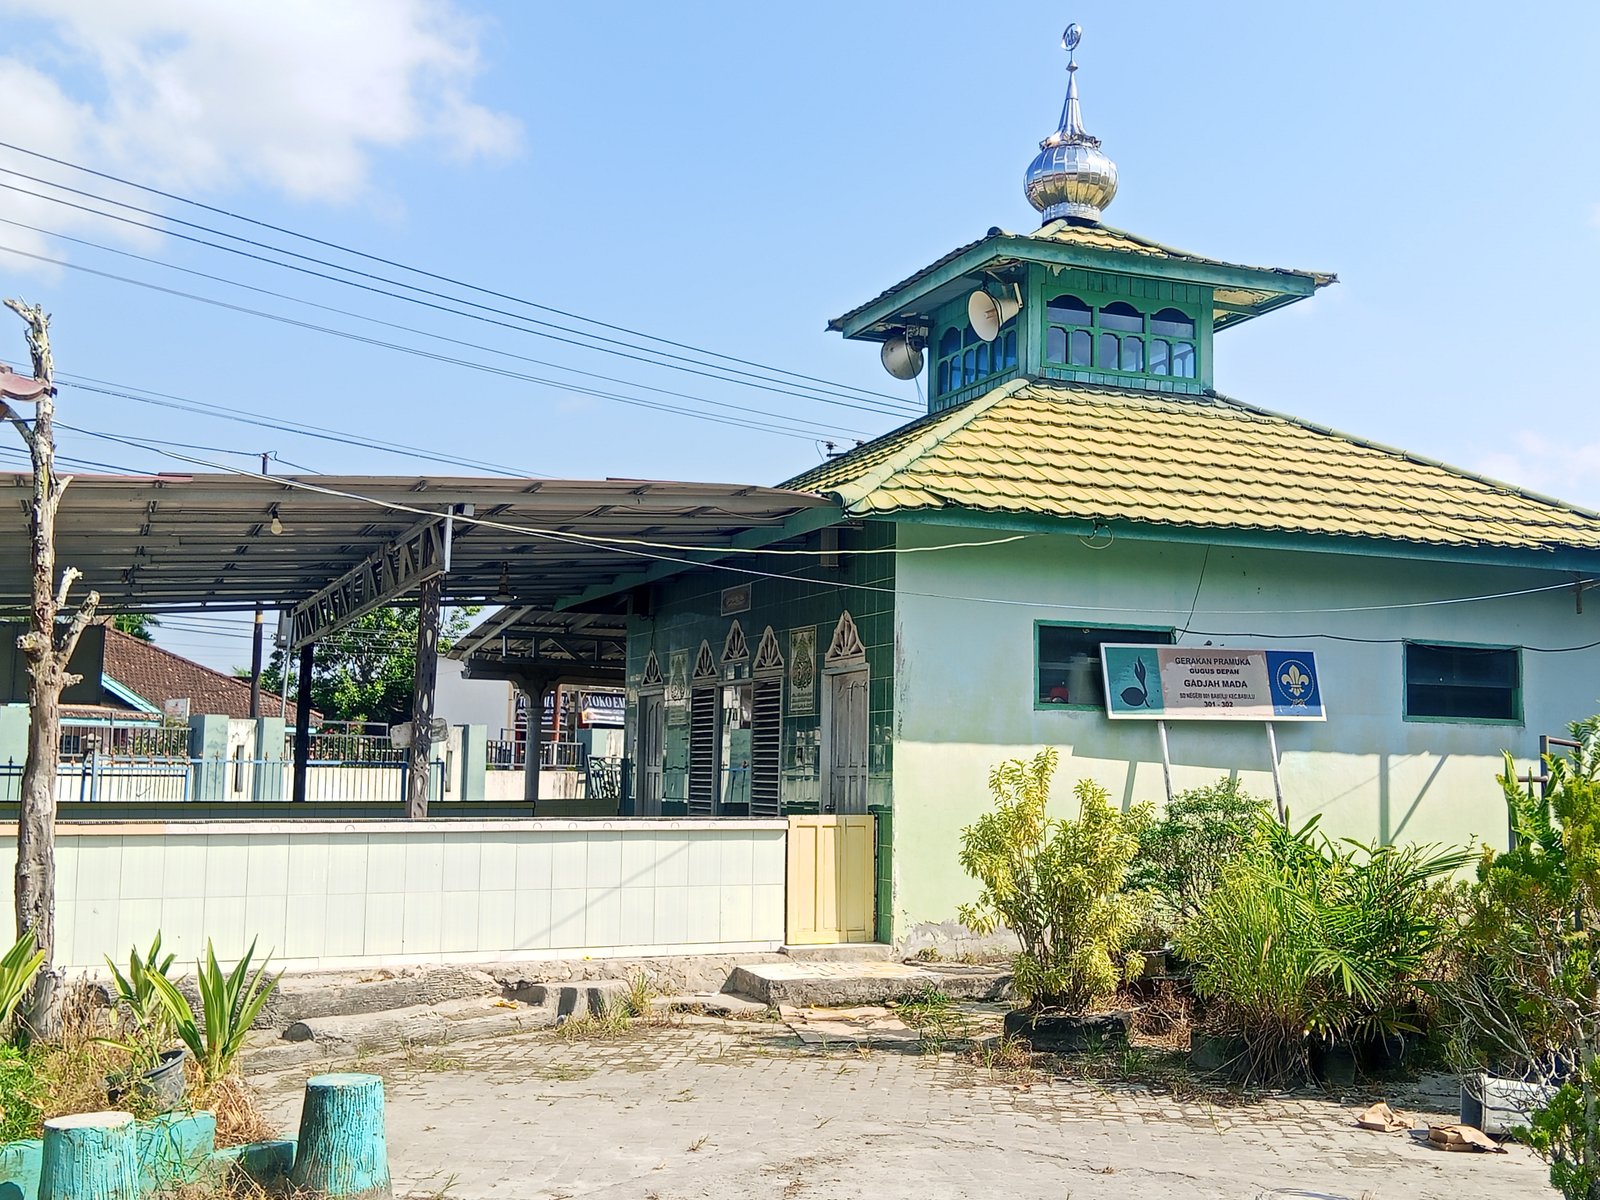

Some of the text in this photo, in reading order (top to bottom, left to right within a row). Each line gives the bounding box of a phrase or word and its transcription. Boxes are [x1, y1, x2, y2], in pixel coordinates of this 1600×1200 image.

[1175, 657, 1212, 665] GERAKAN
[1184, 679, 1220, 688] GADJAH
[586, 695, 612, 708] TOKO
